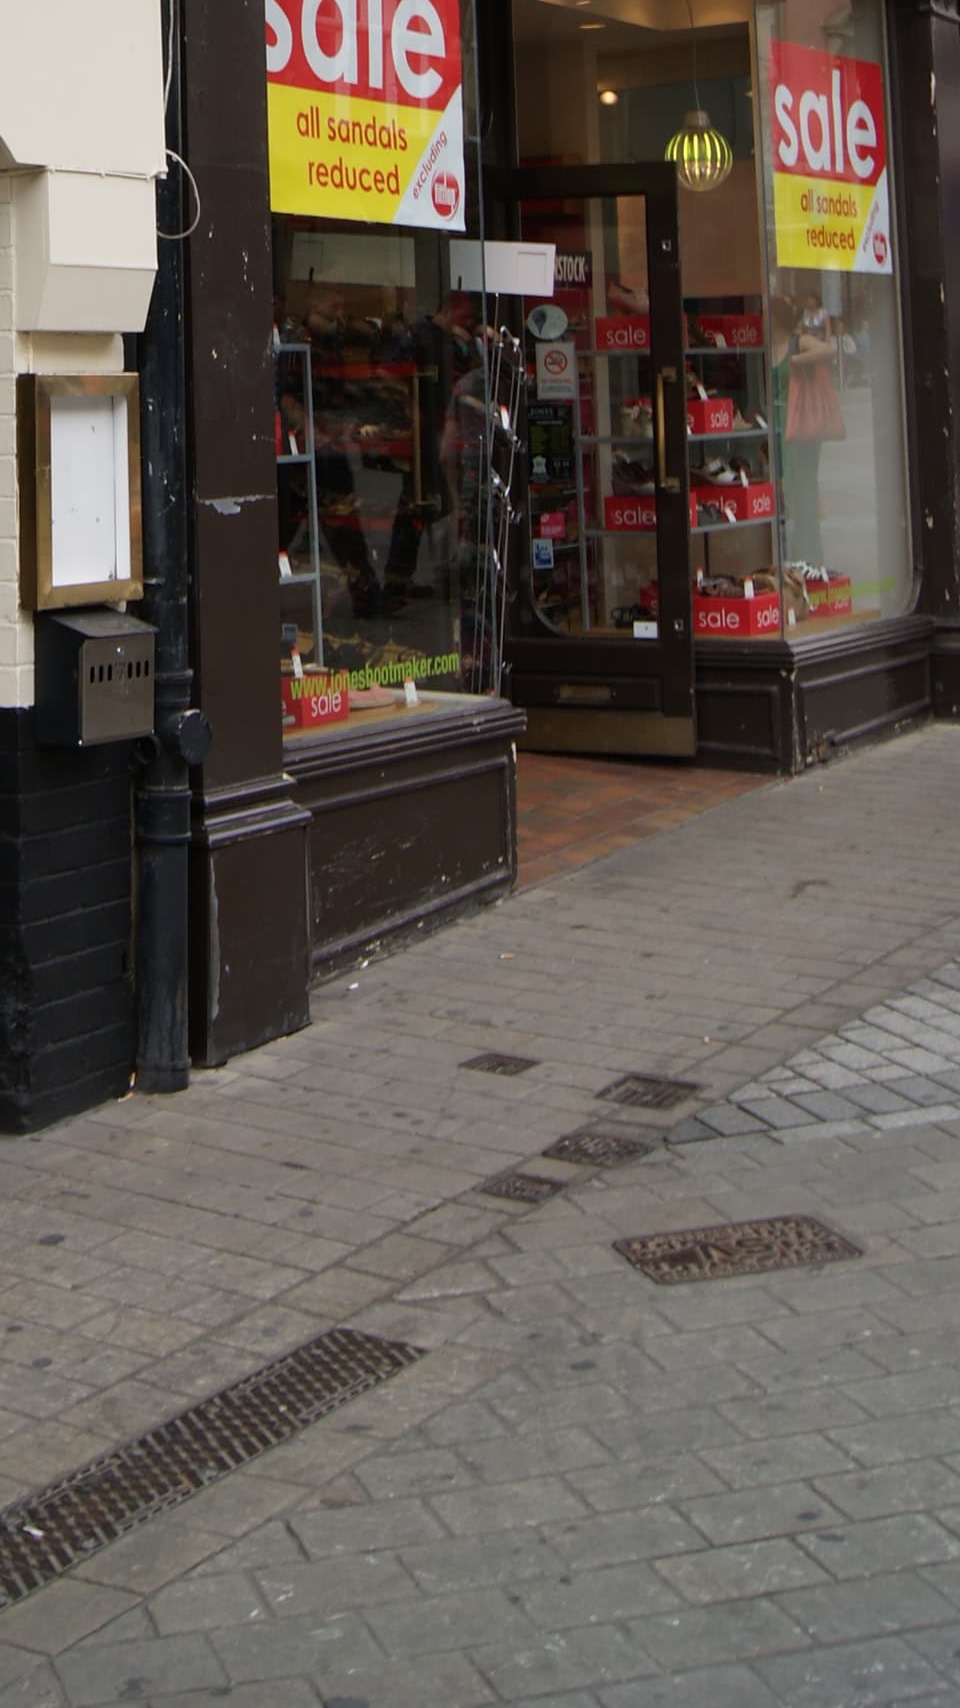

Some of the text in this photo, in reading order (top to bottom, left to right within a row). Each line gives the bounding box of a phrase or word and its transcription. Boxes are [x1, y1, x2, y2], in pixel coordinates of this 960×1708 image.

[296, 106, 409, 152] all sandals
[775, 69, 877, 178] sale
[307, 156, 401, 196] reduced
[412, 130, 448, 200] excluding
[800, 188, 858, 219] all sandals
[806, 224, 856, 251] reduced
[606, 325, 647, 346] sale
[731, 323, 757, 343] sale
[710, 408, 730, 429] sale
[752, 493, 771, 515] sale
[698, 607, 740, 629] sale
[756, 607, 779, 629] sale
[290, 652, 460, 700] www.jonesbootmaker.com
[311, 691, 342, 718] sale
